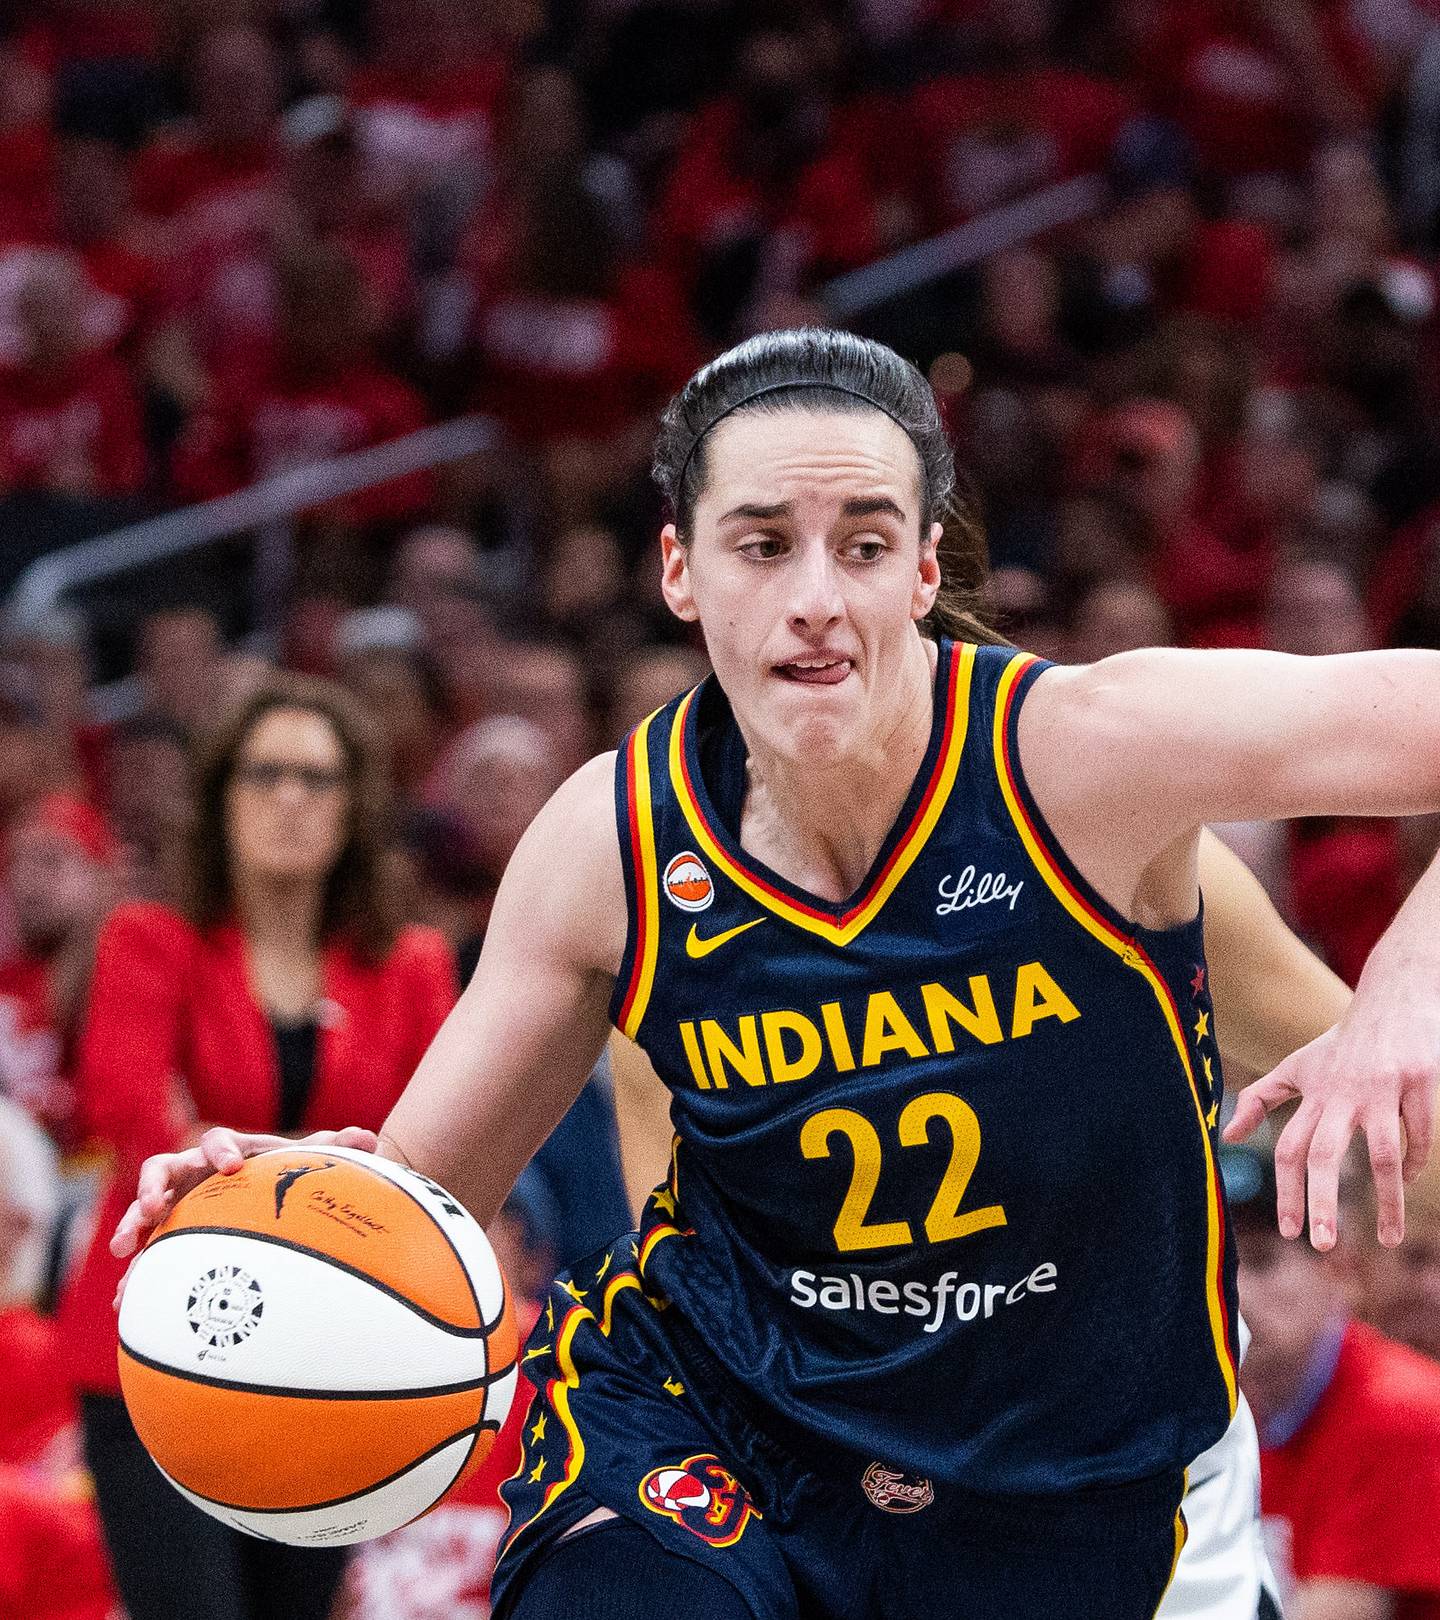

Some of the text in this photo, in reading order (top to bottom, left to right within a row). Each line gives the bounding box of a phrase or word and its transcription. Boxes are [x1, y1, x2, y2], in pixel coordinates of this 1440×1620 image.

[935, 864, 1024, 915] Lilly
[678, 961, 1082, 1090] INDIANA
[799, 1091, 1008, 1252] 22
[790, 1262, 1058, 1333] salesforce
